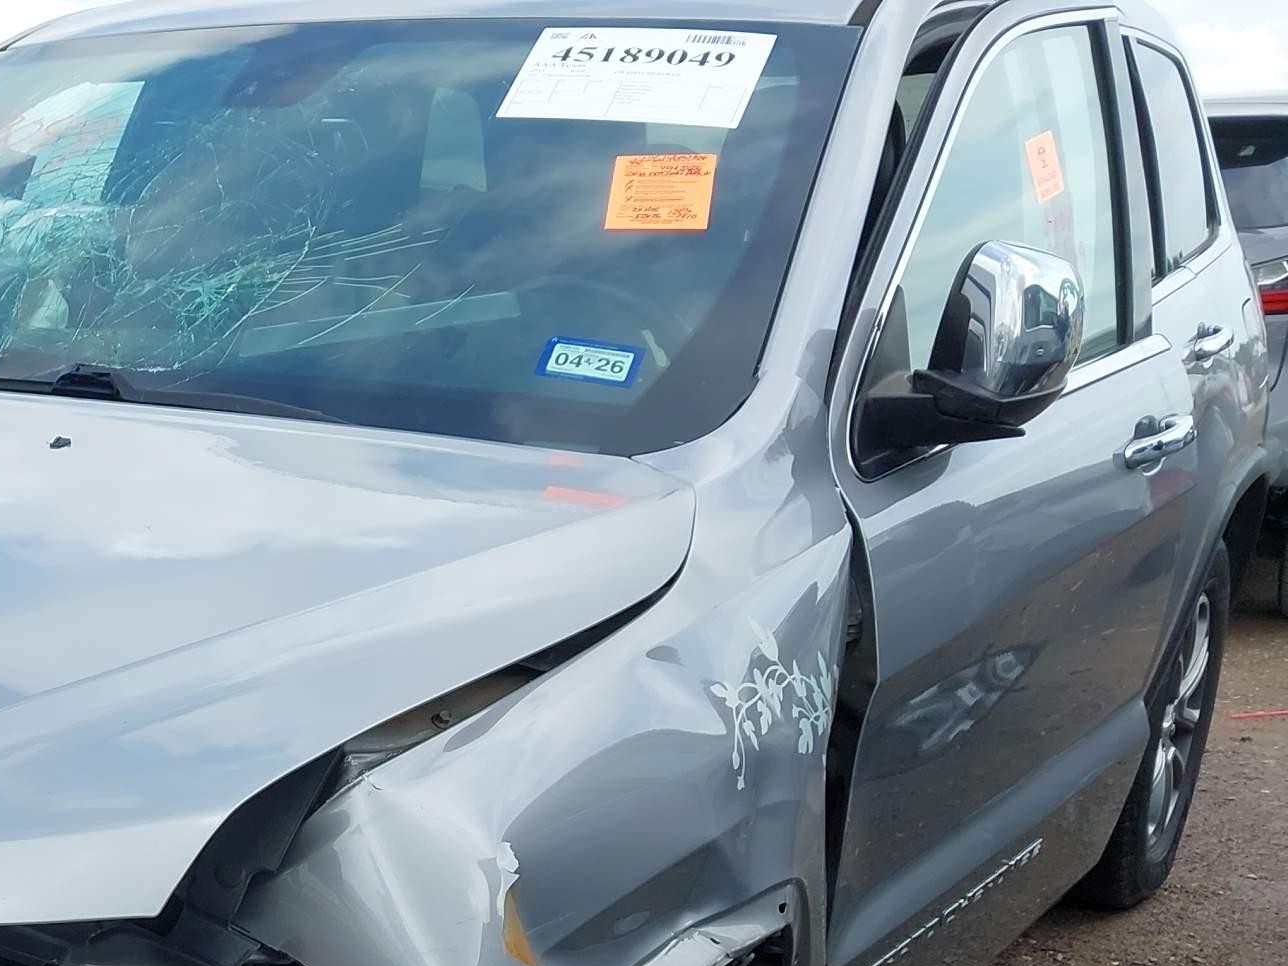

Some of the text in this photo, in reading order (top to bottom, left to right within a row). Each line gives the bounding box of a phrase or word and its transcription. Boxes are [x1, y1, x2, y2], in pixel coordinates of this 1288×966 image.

[552, 45, 736, 68] 45189049
[554, 351, 626, 375] 04 26
